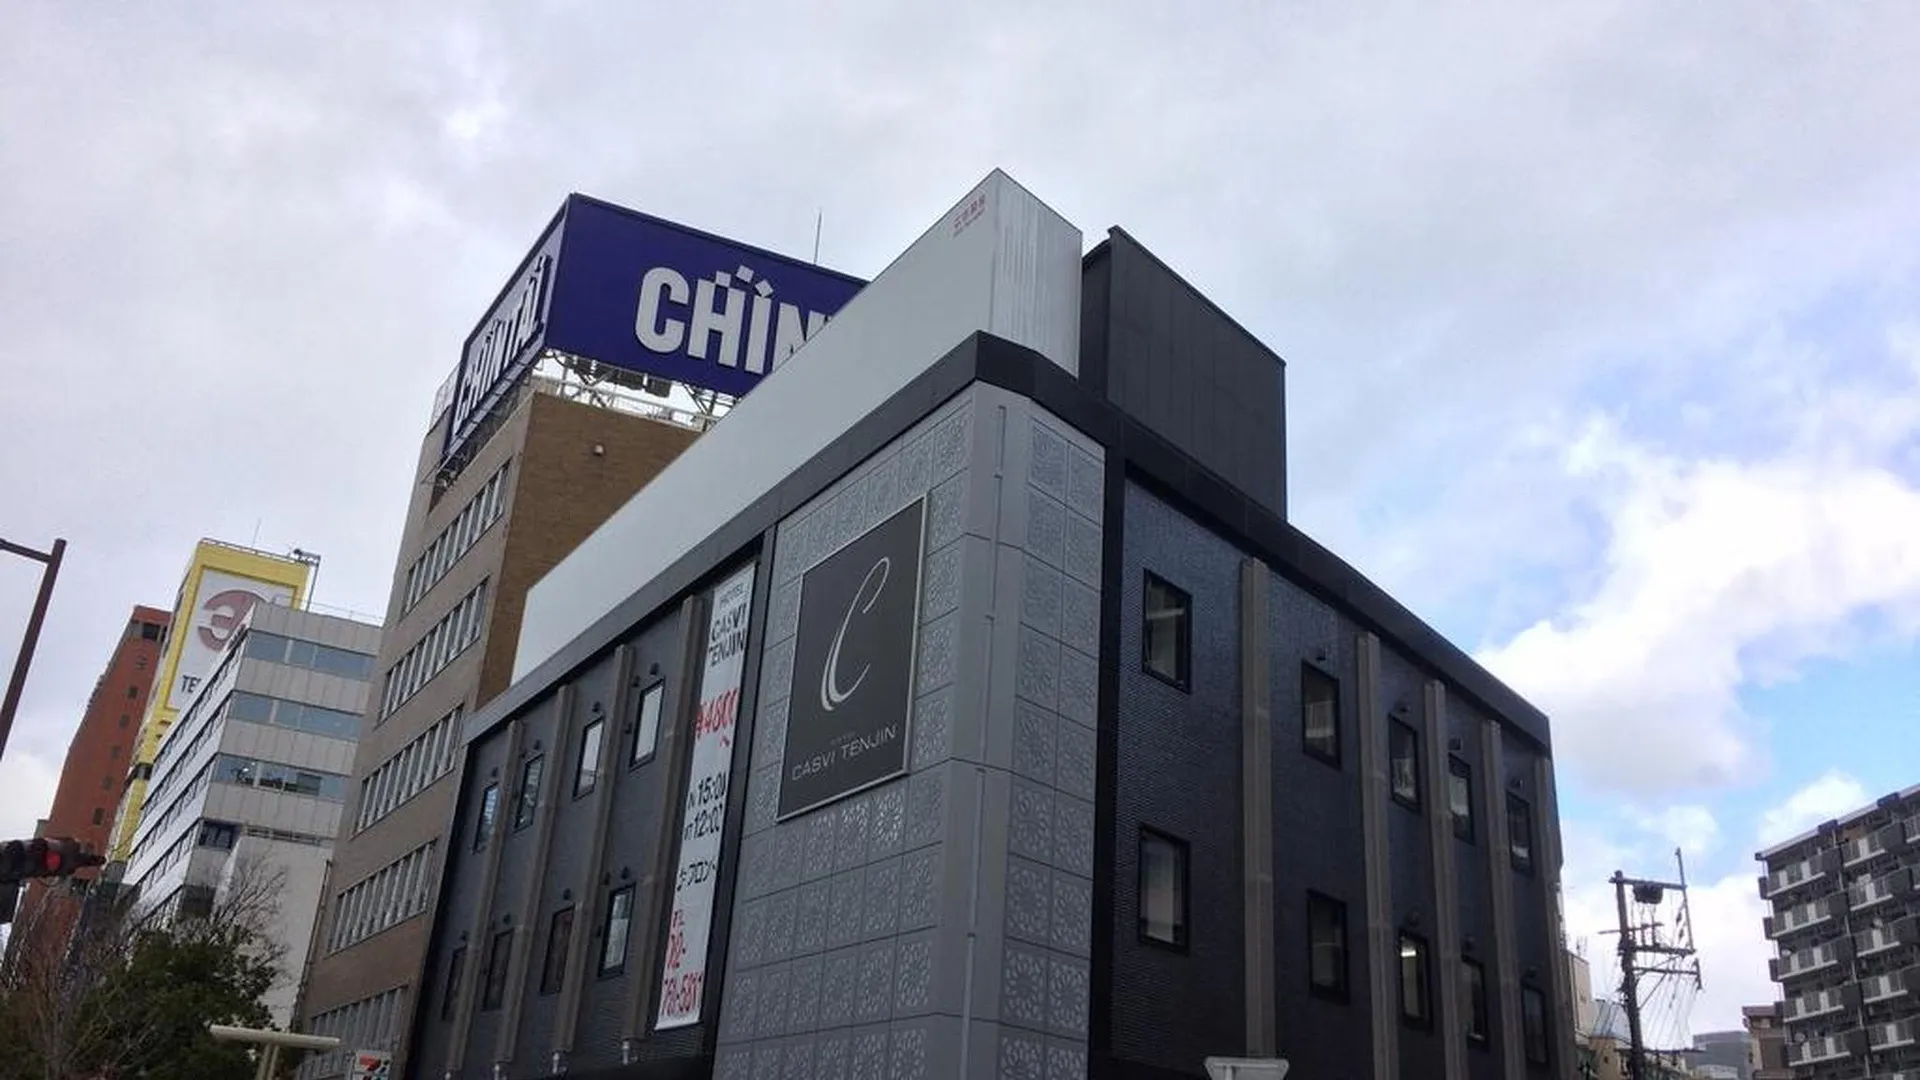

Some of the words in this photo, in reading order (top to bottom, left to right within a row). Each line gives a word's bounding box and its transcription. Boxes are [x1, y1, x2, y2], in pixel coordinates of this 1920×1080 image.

[708, 627, 745, 667] TENJIN
[792, 750, 836, 781] CASVI
[841, 723, 897, 759] TENJIN
